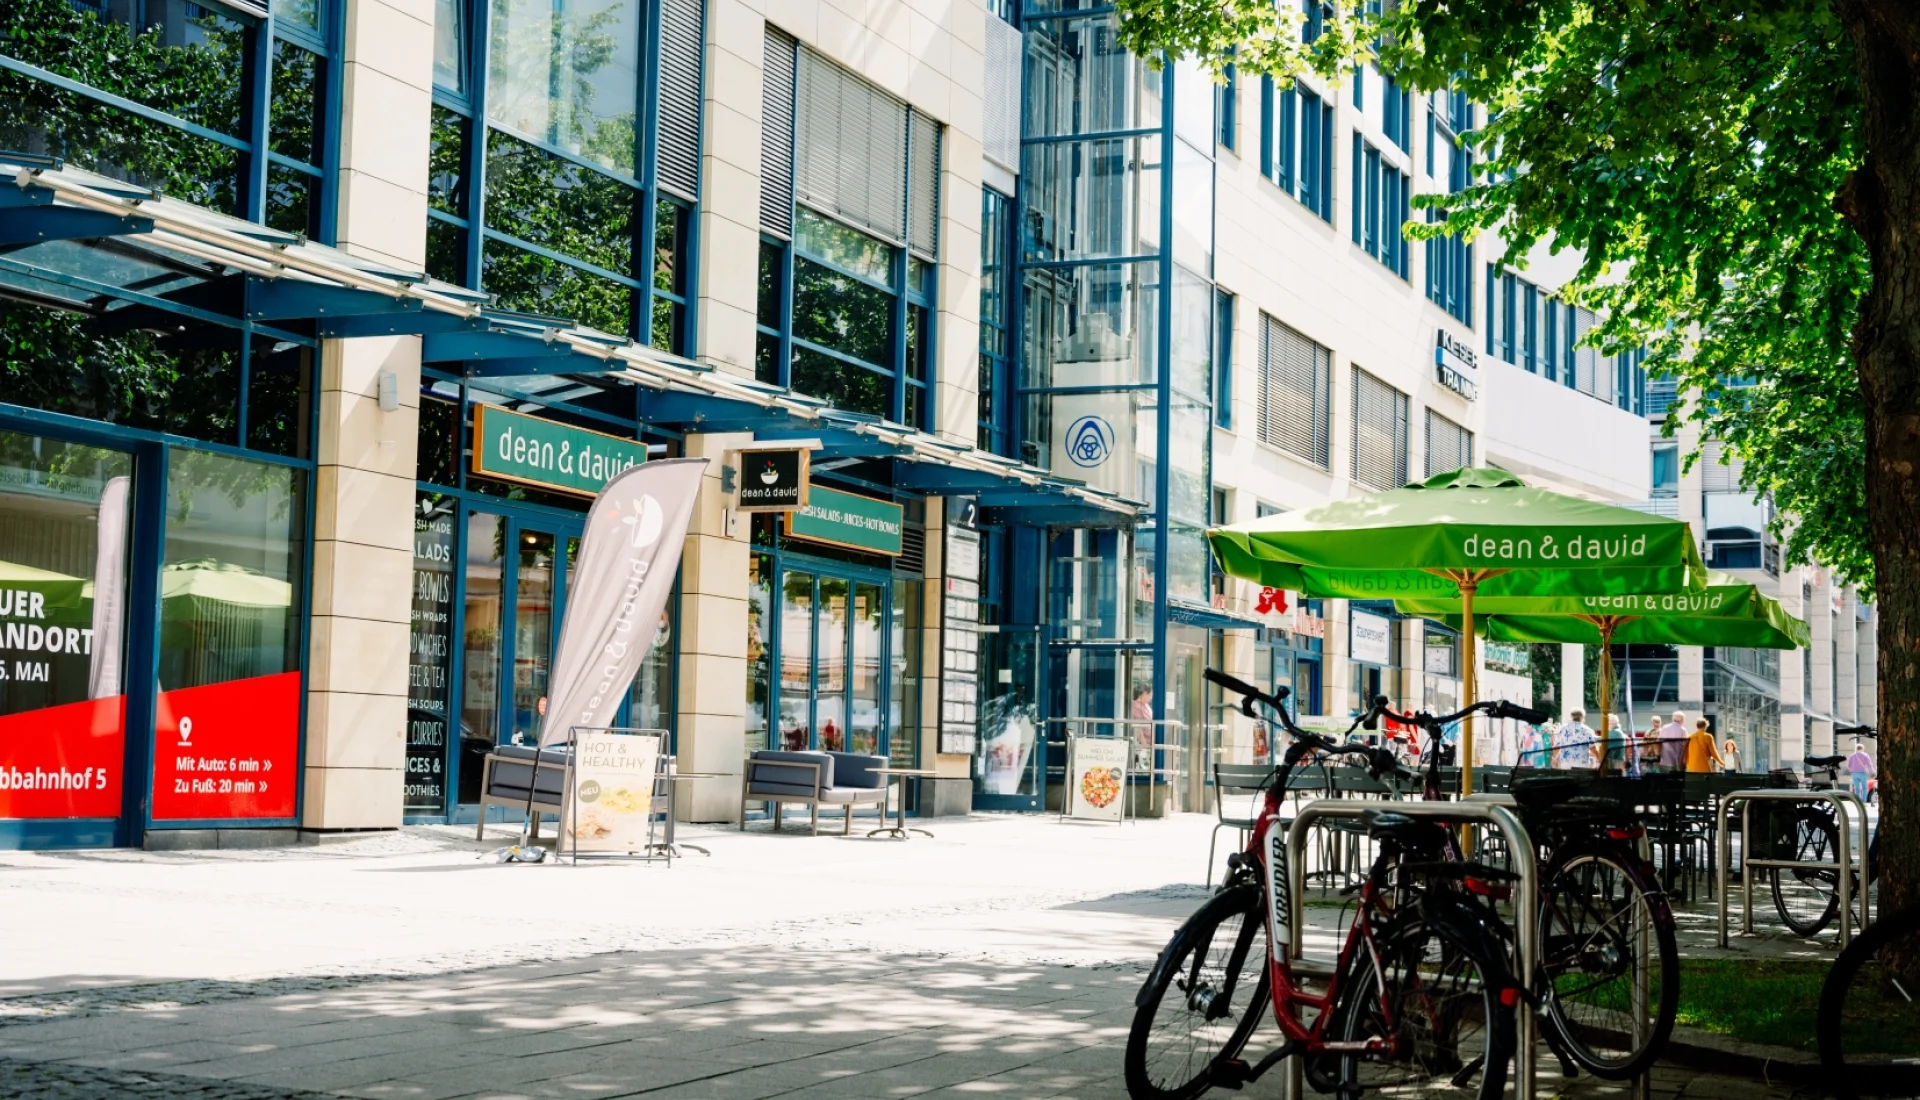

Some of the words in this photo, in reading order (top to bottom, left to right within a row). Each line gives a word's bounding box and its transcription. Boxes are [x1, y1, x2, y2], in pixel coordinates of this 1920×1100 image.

[499, 427, 554, 471] dean
[558, 440, 574, 475] &
[741, 487, 763, 498] dean
[764, 487, 772, 498] &
[772, 486, 798, 498] david
[817, 507, 840, 522] SALADS
[842, 513, 863, 528] JUICES
[866, 518, 878, 531] HOT
[878, 519, 900, 536] BOWLS
[967, 504, 976, 528] 2
[429, 521, 452, 535] MADE
[1464, 534, 1532, 559] dean
[1539, 535, 1560, 559] &
[1568, 534, 1646, 559] david
[419, 571, 449, 603] BOWLS
[1644, 597, 1656, 610] &
[1662, 593, 1723, 611] david
[422, 611, 447, 623] WRAPS
[581, 665, 618, 723] dean
[604, 641, 627, 659] &
[616, 558, 649, 633] david
[15, 660, 50, 682] MAI
[423, 665, 430, 688] &
[432, 665, 446, 688] TEA
[419, 699, 444, 710] SOUPS
[412, 720, 444, 746] CURRIES
[584, 742, 614, 754] HOT
[617, 743, 627, 754] &
[176, 756, 195, 771] Mit
[197, 757, 227, 771] Auto:
[229, 758, 236, 771] 6
[239, 758, 259, 771] min
[433, 757, 441, 774] &
[582, 756, 646, 769] HEALTHY
[96, 767, 107, 790] 5
[174, 778, 189, 793] Zu
[192, 778, 216, 793] Fuß:
[219, 779, 231, 793] 20
[234, 779, 255, 793] min
[580, 785, 599, 797] NEU
[1272, 835, 1289, 927] KREIDLER
